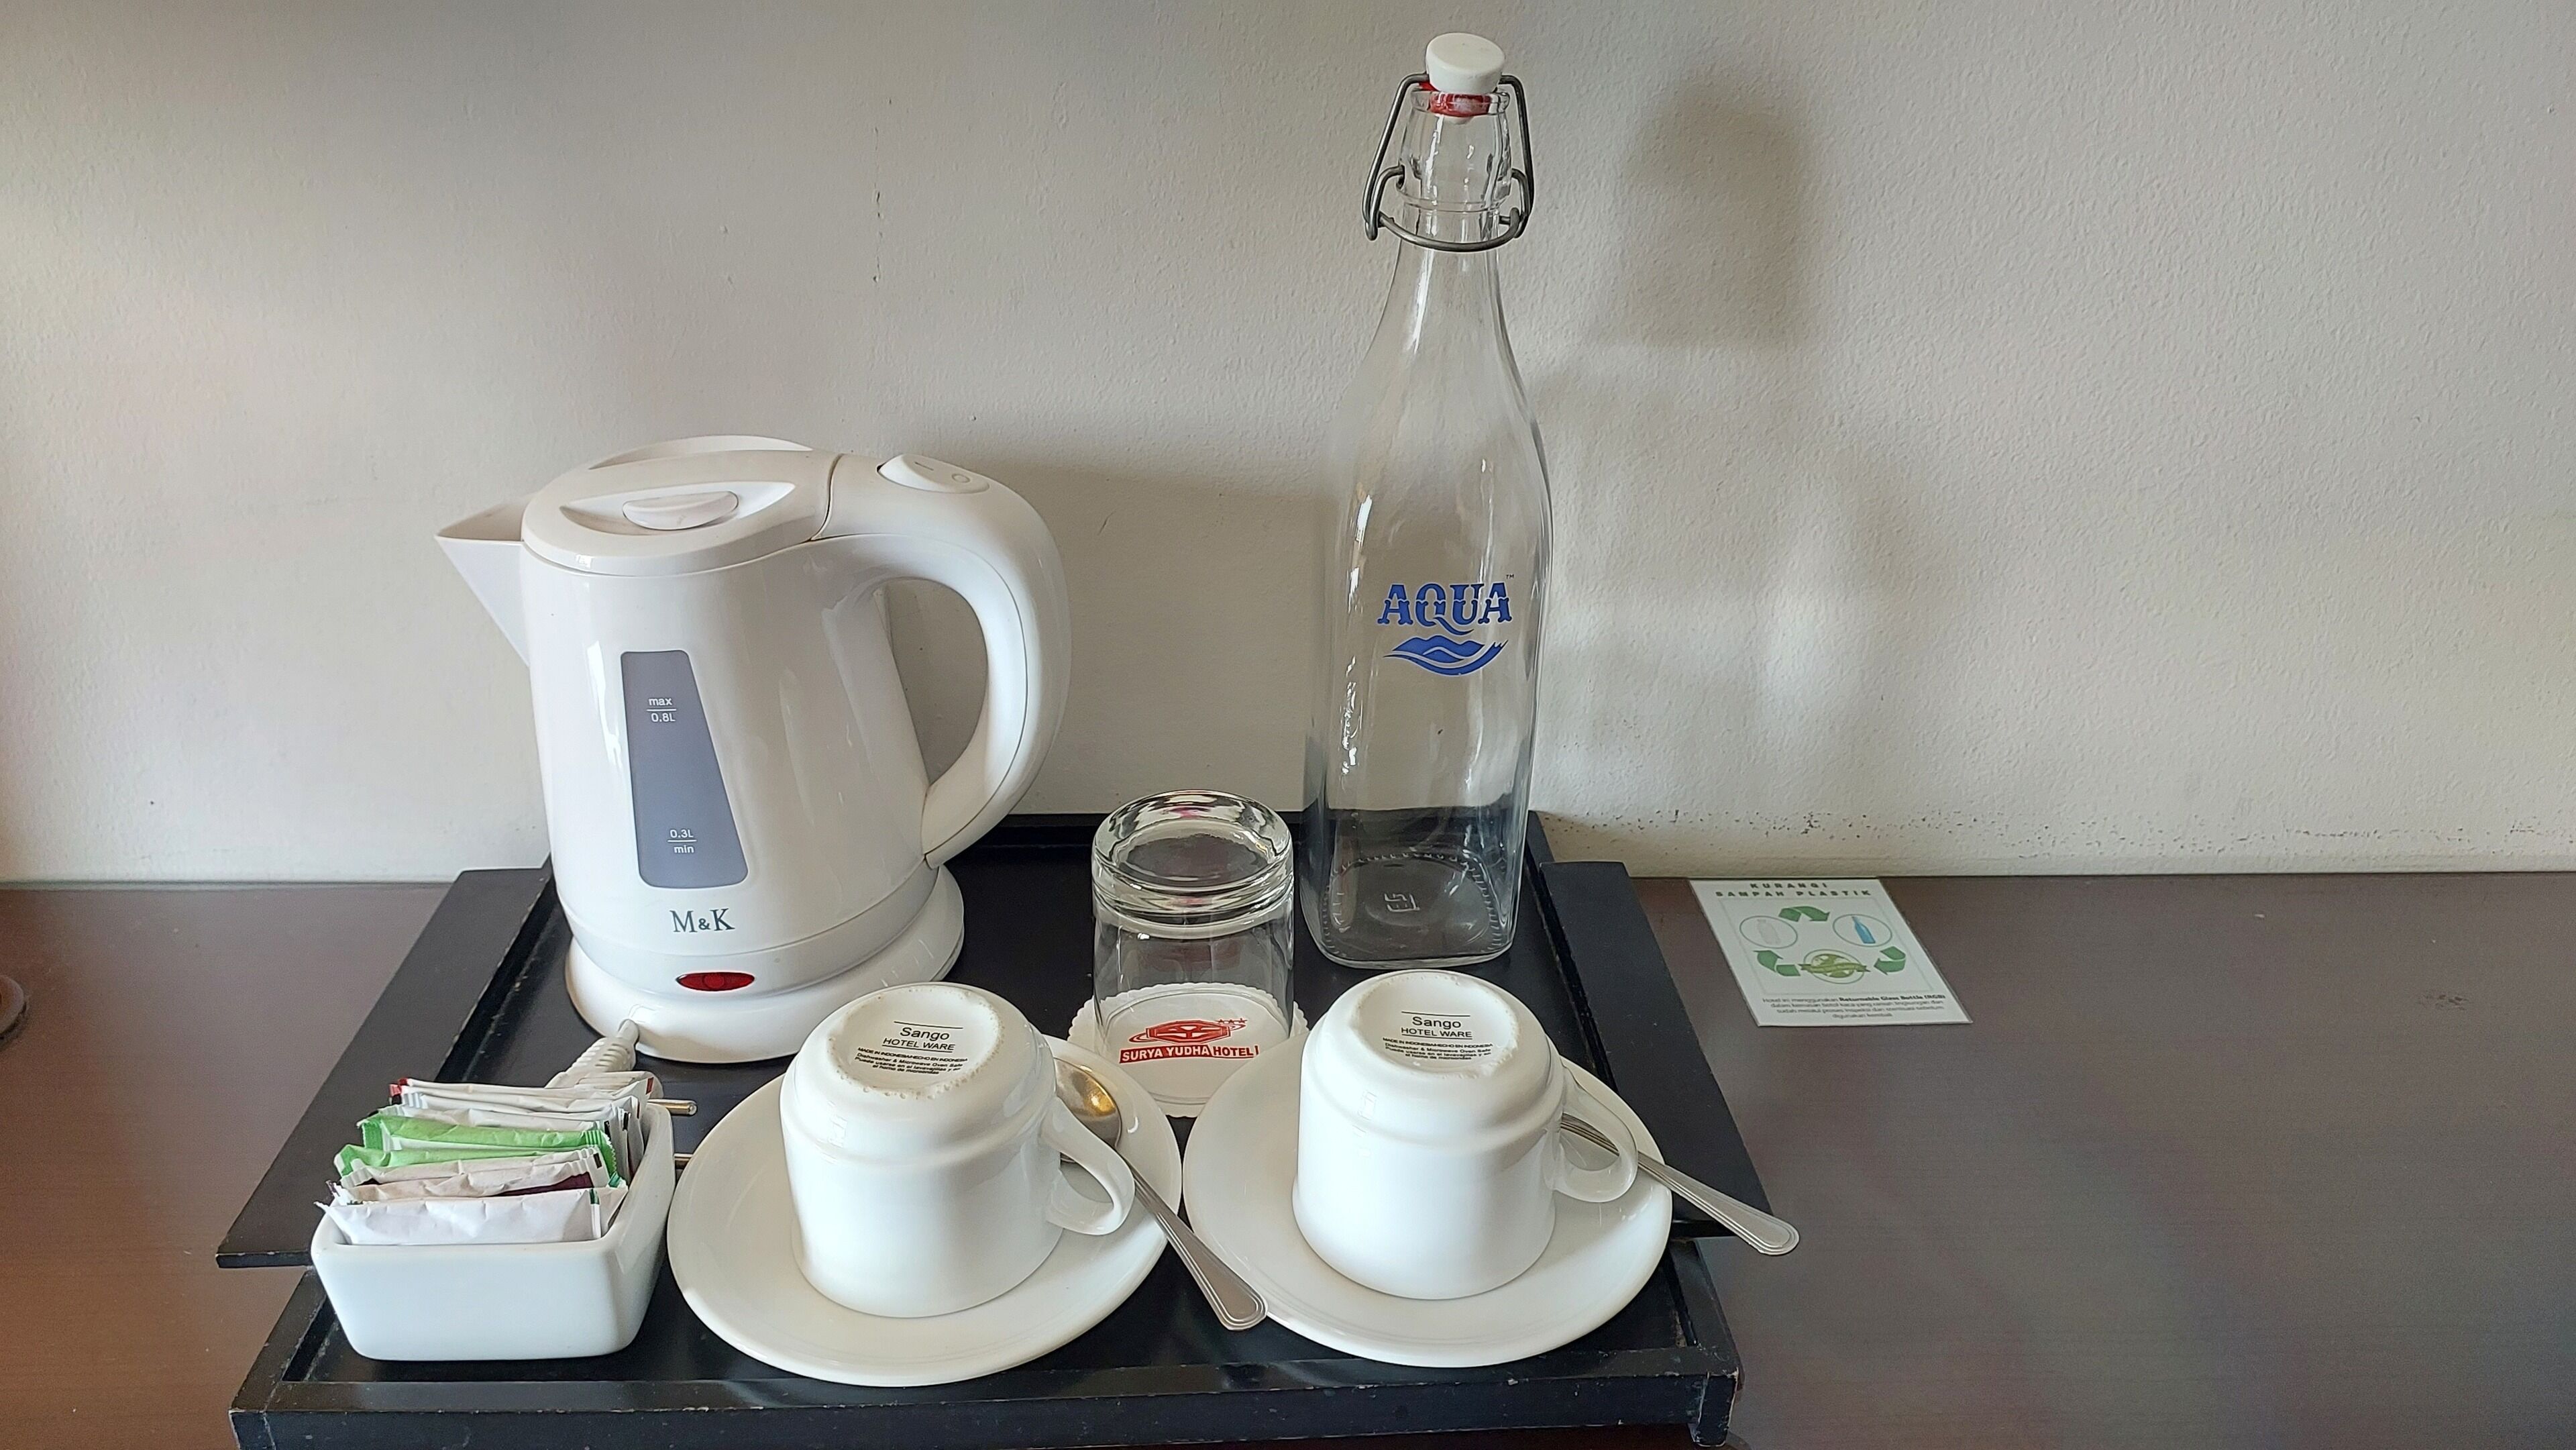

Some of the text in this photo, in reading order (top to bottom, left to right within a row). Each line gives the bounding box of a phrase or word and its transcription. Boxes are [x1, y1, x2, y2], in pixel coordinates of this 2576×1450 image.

[1377, 582, 1513, 635] AQUA
[648, 698, 673, 706] max
[651, 713, 676, 722] 0.8L
[669, 829, 694, 838] 0.3L
[674, 845, 695, 853] min
[669, 908, 735, 933] M&K
[1412, 1016, 1461, 1030] Sango
[900, 1027, 950, 1041] Sango
[1401, 1027, 1438, 1037] HOTEL
[883, 1037, 956, 1051] HOTEL WARE
[857, 1053, 892, 1061] Dishwasher
[1122, 1045, 1254, 1061] SURYA YUDHA HOTEL
